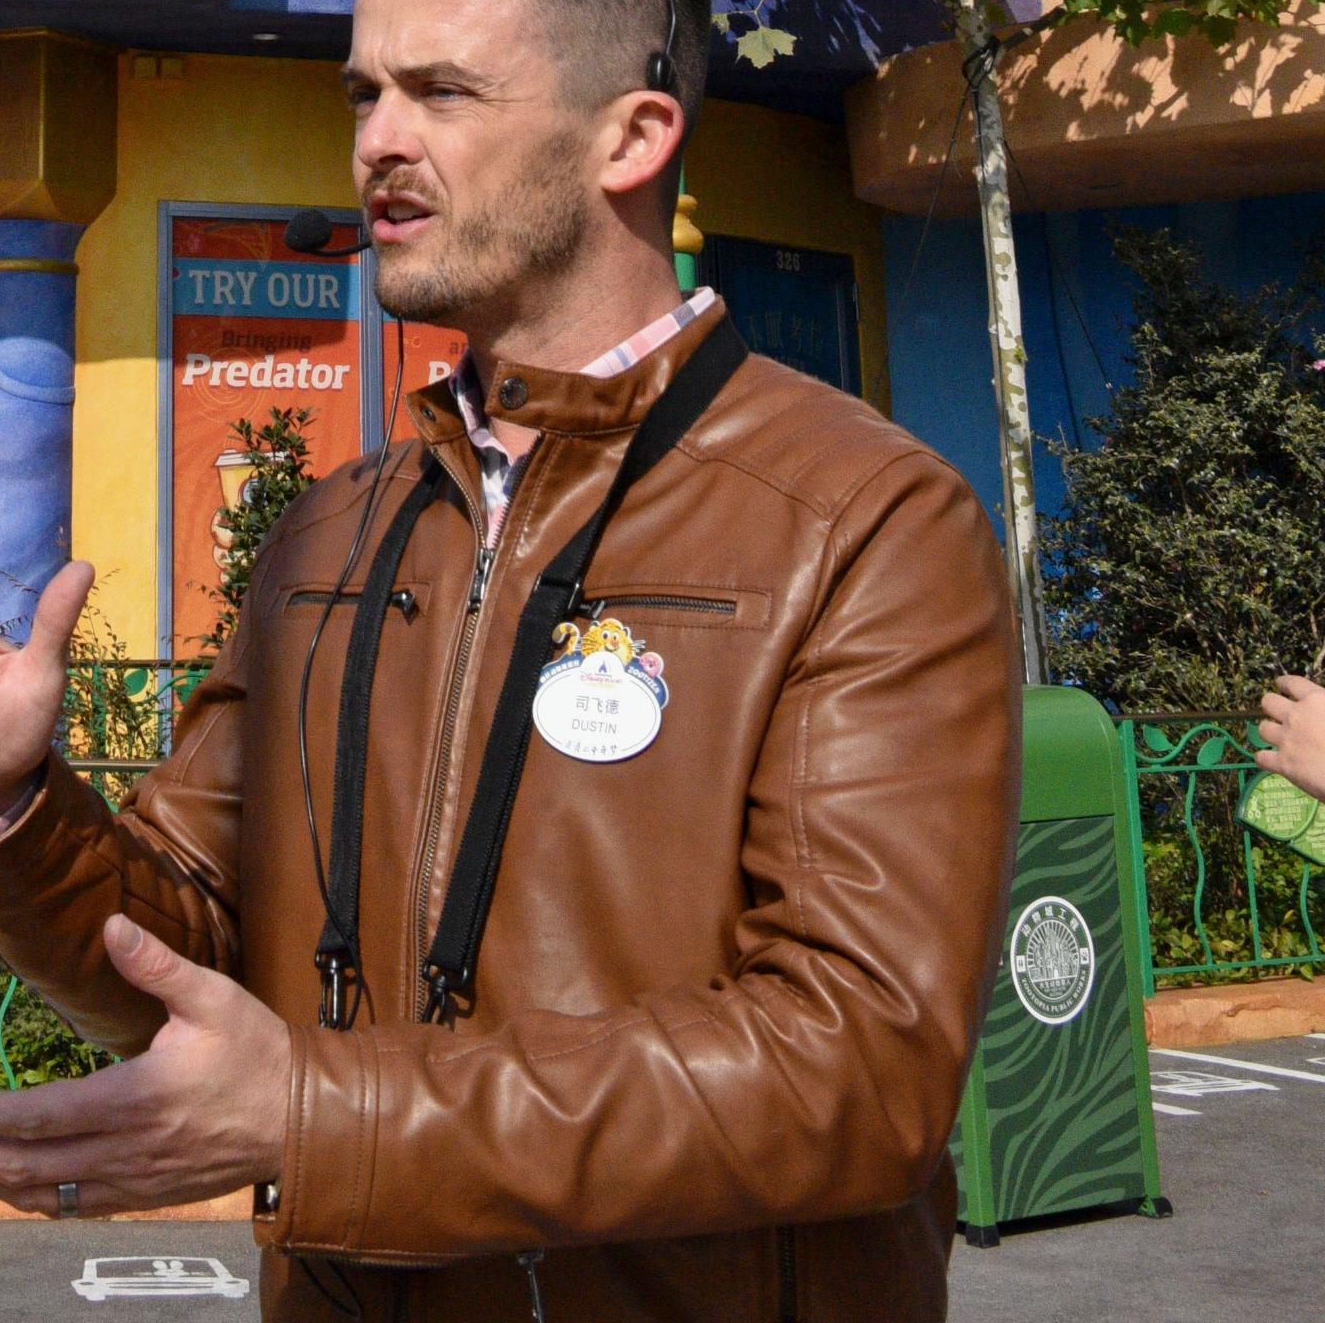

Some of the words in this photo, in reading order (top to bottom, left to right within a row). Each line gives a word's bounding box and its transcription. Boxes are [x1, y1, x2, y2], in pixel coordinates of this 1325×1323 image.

[775, 250, 801, 272] 326
[189, 269, 257, 306] TRY
[268, 271, 341, 309] OUR
[182, 354, 350, 390] Predator
[572, 718, 617, 734] DUSTIN
